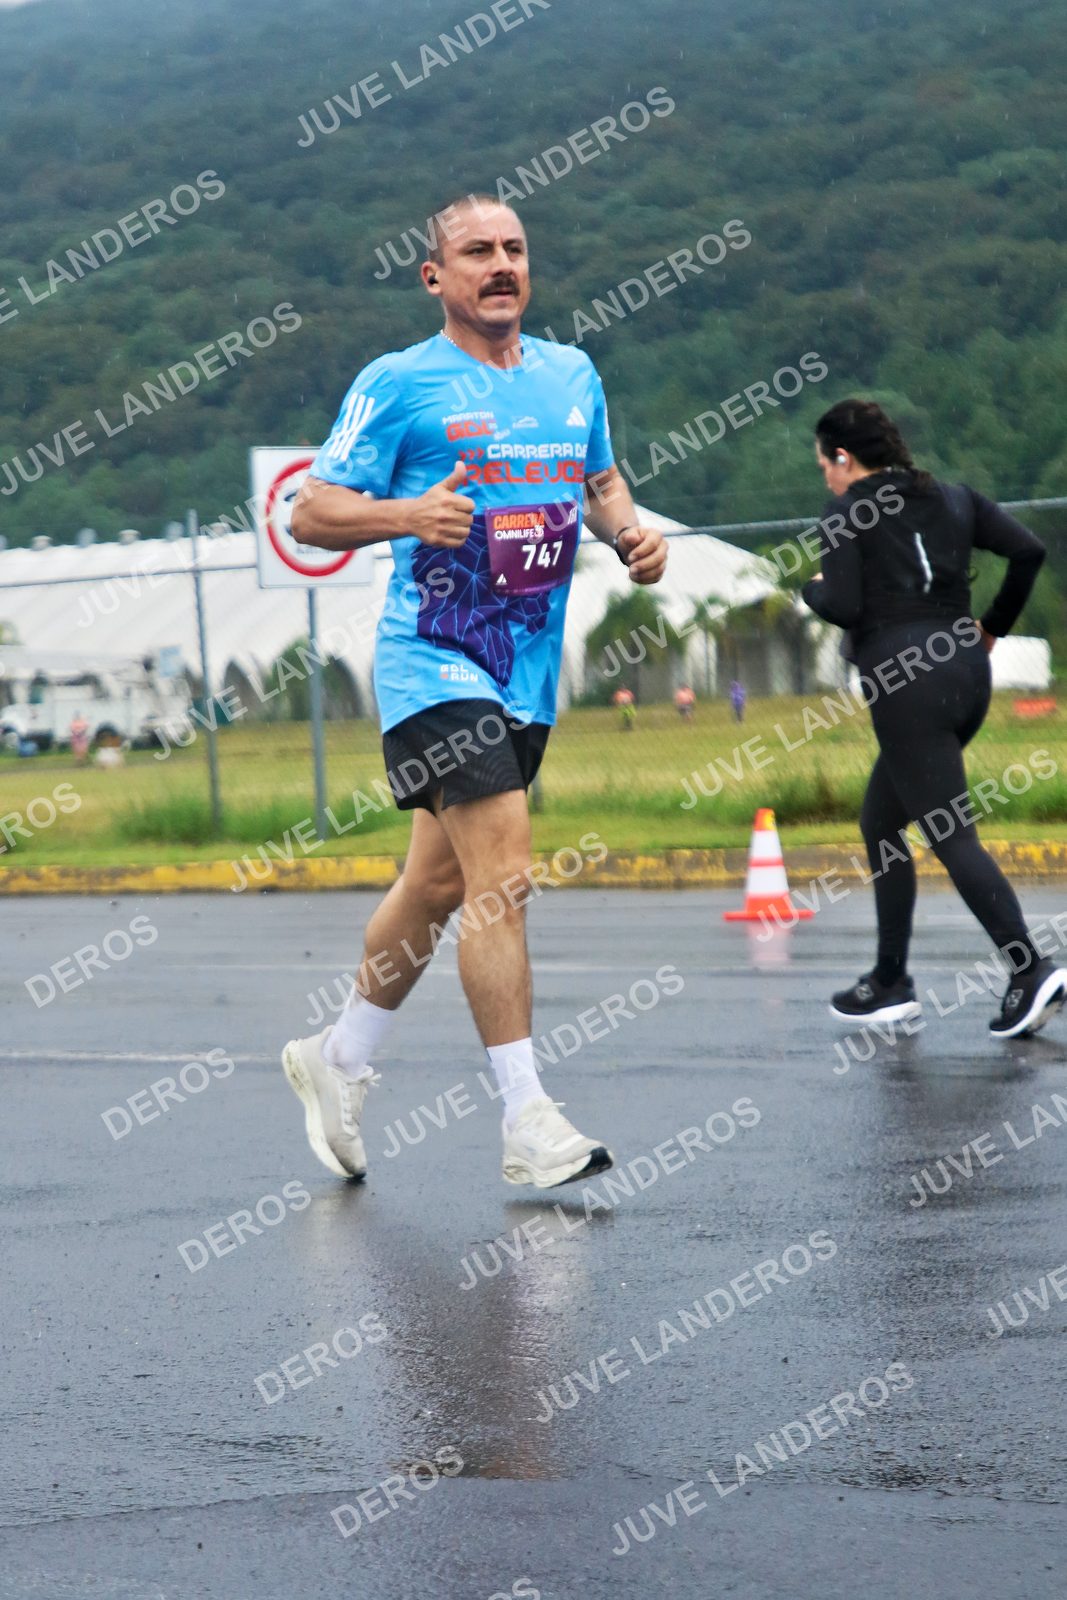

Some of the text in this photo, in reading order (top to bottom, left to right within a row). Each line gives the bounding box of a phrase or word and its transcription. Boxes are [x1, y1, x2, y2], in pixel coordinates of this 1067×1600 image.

[487, 443, 573, 458] CARRERA
[494, 512, 545, 530] CARRERA
[522, 540, 563, 571] 747
[451, 672, 479, 682] RUN
